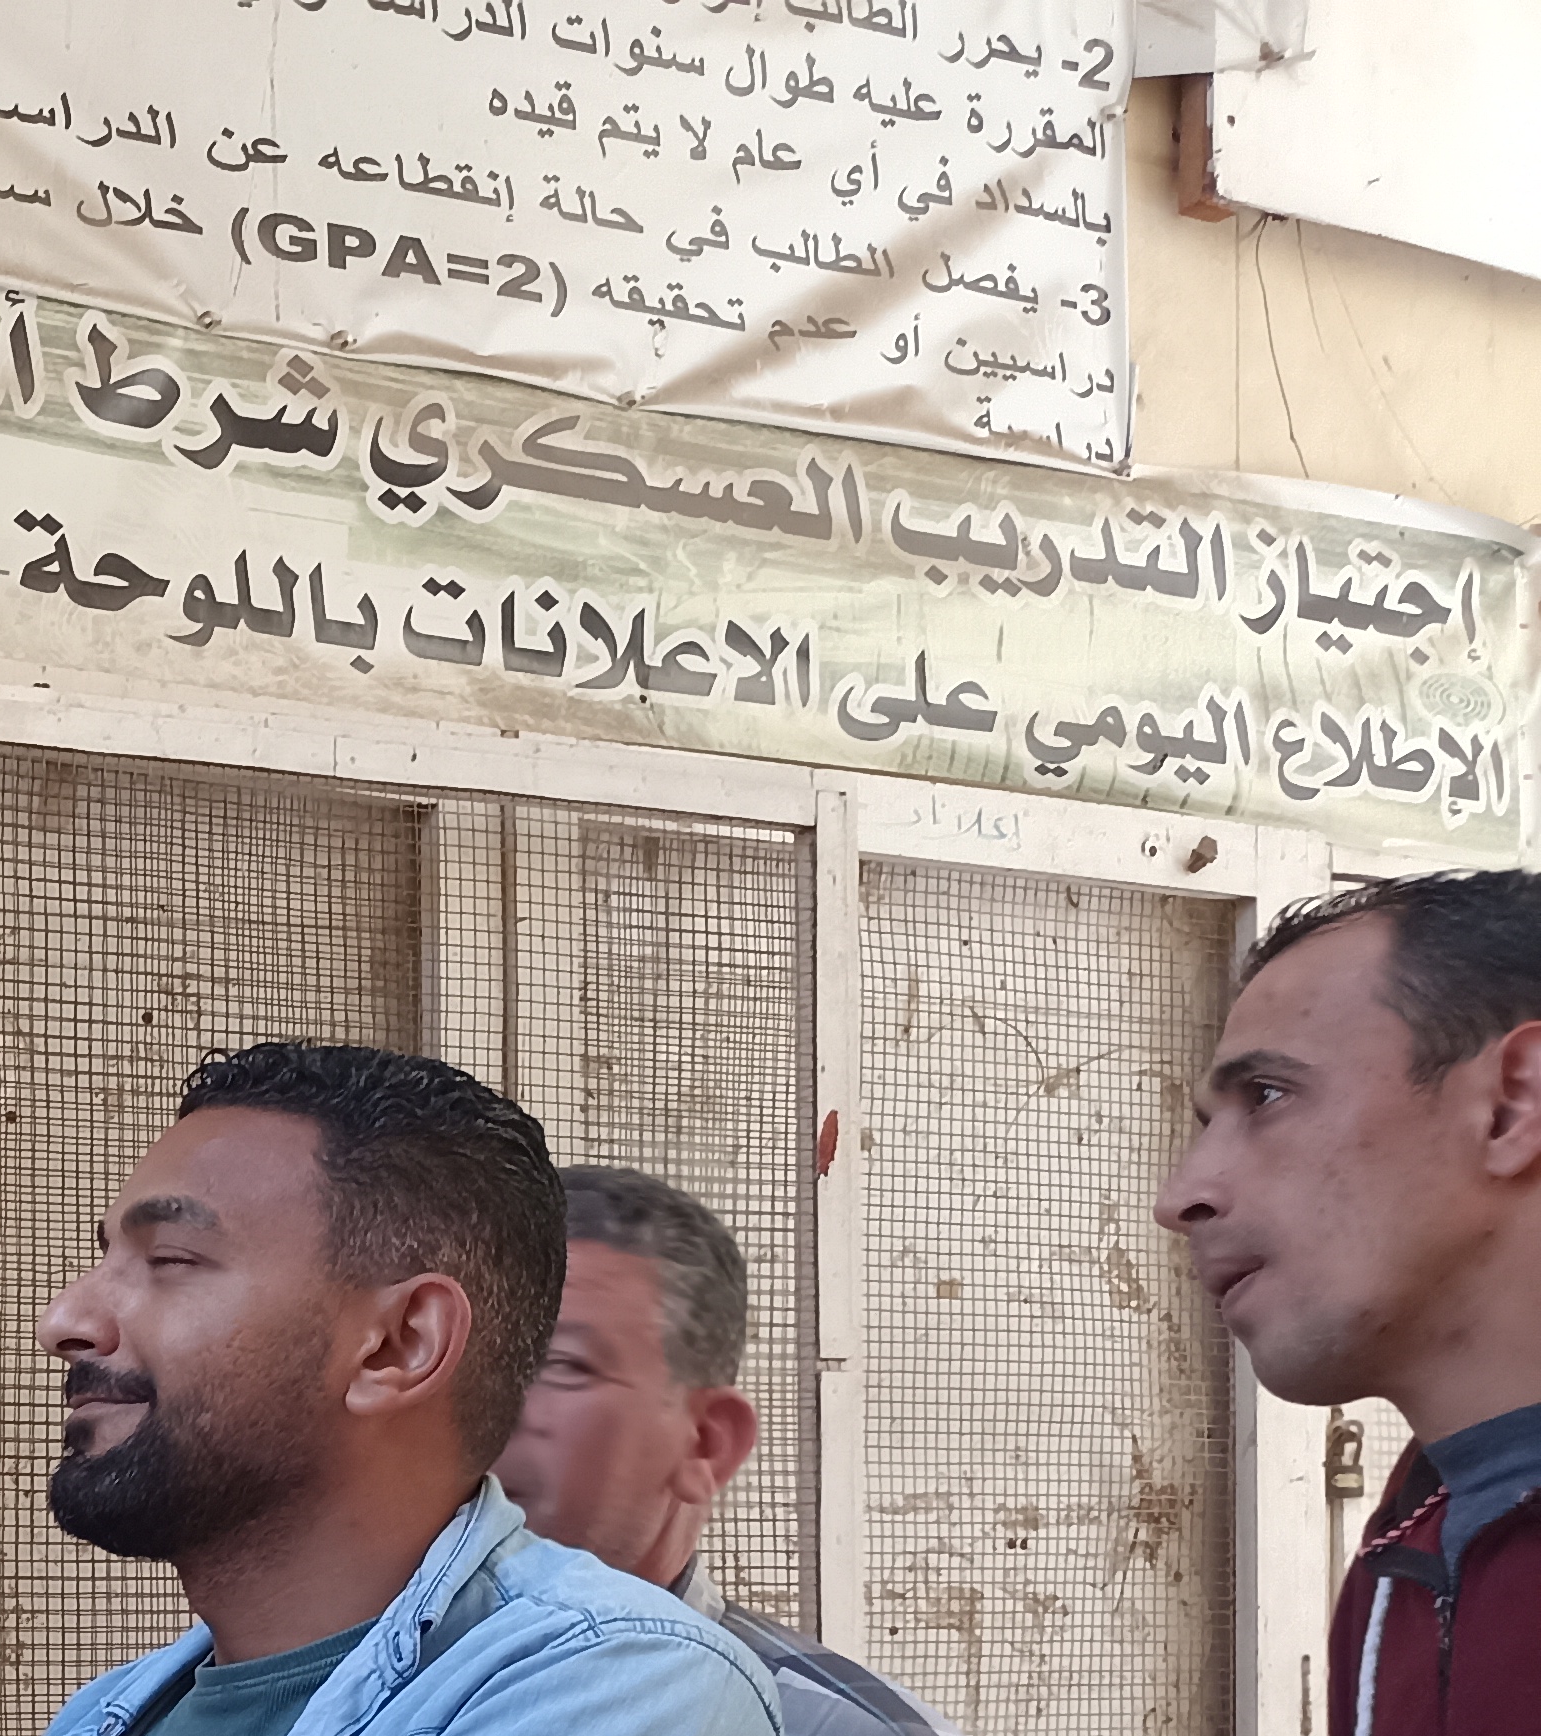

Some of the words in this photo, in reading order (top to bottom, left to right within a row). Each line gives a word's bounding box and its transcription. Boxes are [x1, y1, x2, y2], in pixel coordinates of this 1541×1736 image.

[552, 15, 705, 76] سنوات
[725, 43, 834, 108] طوال
[938, 30, 1042, 78] يحرر
[489, 80, 577, 139] قيده
[598, 103, 660, 159] يتم
[853, 75, 942, 128] عليه
[967, 93, 1105, 159] المقررة
[207, 128, 287, 171] عن
[680, 114, 711, 160] لا
[732, 128, 802, 185] عام
[318, 146, 514, 222] إنقطاعه
[540, 174, 643, 233] حالة
[831, 140, 878, 206] أي
[898, 156, 953, 222] في
[76, 181, 203, 235] خلال
[666, 205, 729, 262] في
[975, 178, 1111, 247] بالسداد
[752, 228, 894, 278] الطالب
[922, 252, 1038, 313] يفصل
[592, 274, 745, 331] تحقيقه
[768, 315, 857, 351] عدم
[880, 313, 920, 364] أو
[944, 337, 1114, 398] دراسيين
[75, 323, 338, 469] شرط
[370, 403, 863, 544] العسكري
[891, 500, 1227, 597] التدريب
[14, 509, 378, 674] باللوحة
[1240, 530, 1482, 664] إجتياز
[403, 578, 810, 704] الاعلانات
[839, 650, 997, 740] على
[1025, 696, 1250, 785] اليومي
[1274, 705, 1505, 816] الإطلاع
